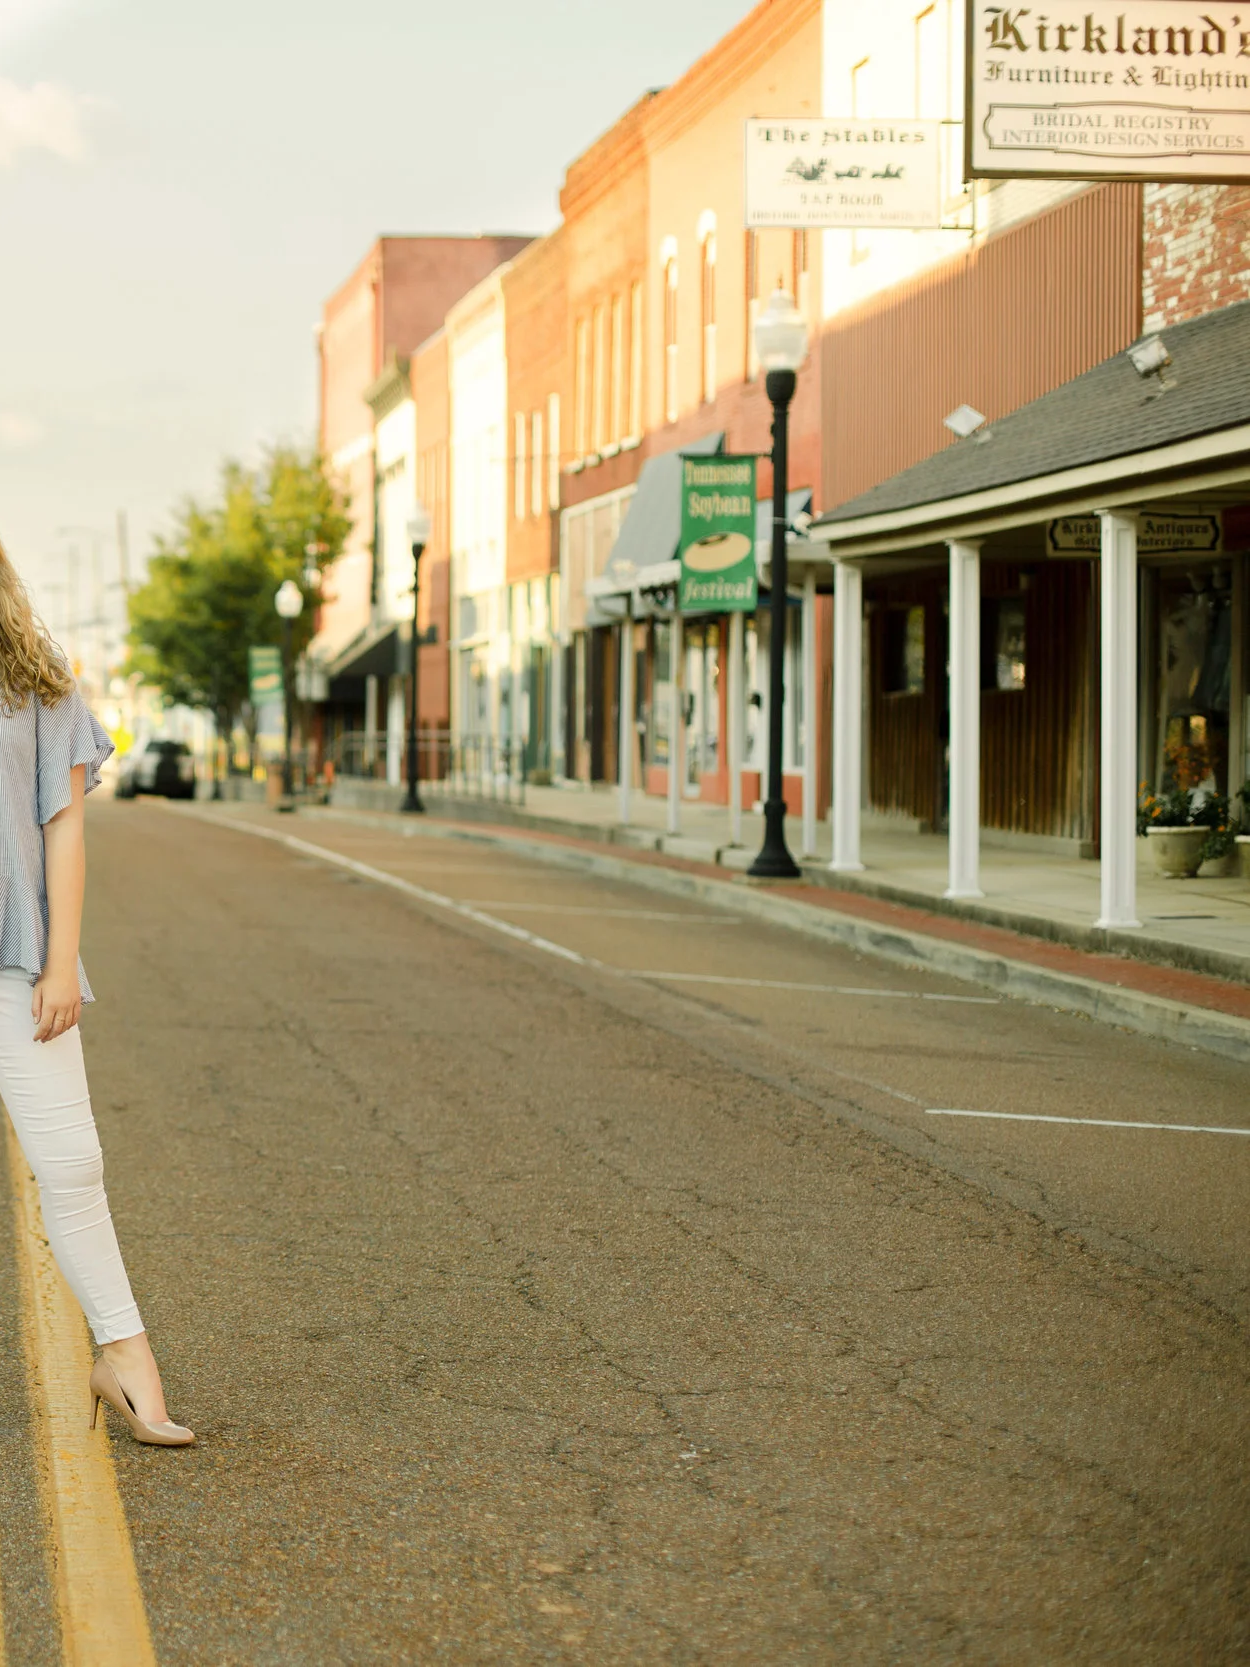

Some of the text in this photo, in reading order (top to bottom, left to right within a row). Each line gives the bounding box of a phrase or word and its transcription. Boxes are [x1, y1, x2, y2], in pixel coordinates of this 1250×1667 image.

[984, 8, 1250, 57] Kirkland's
[983, 60, 1114, 86] Furniture
[1123, 65, 1142, 87] &
[1032, 113, 1214, 131] BRIDAL REGISTRY
[759, 127, 926, 147] The Stables
[1002, 129, 1245, 149] INTERIOR DESIGN SERVICES
[685, 460, 751, 486] Tennessee
[688, 491, 752, 523] Soybean
[1144, 519, 1210, 537] Antiques
[682, 575, 755, 605] festival
